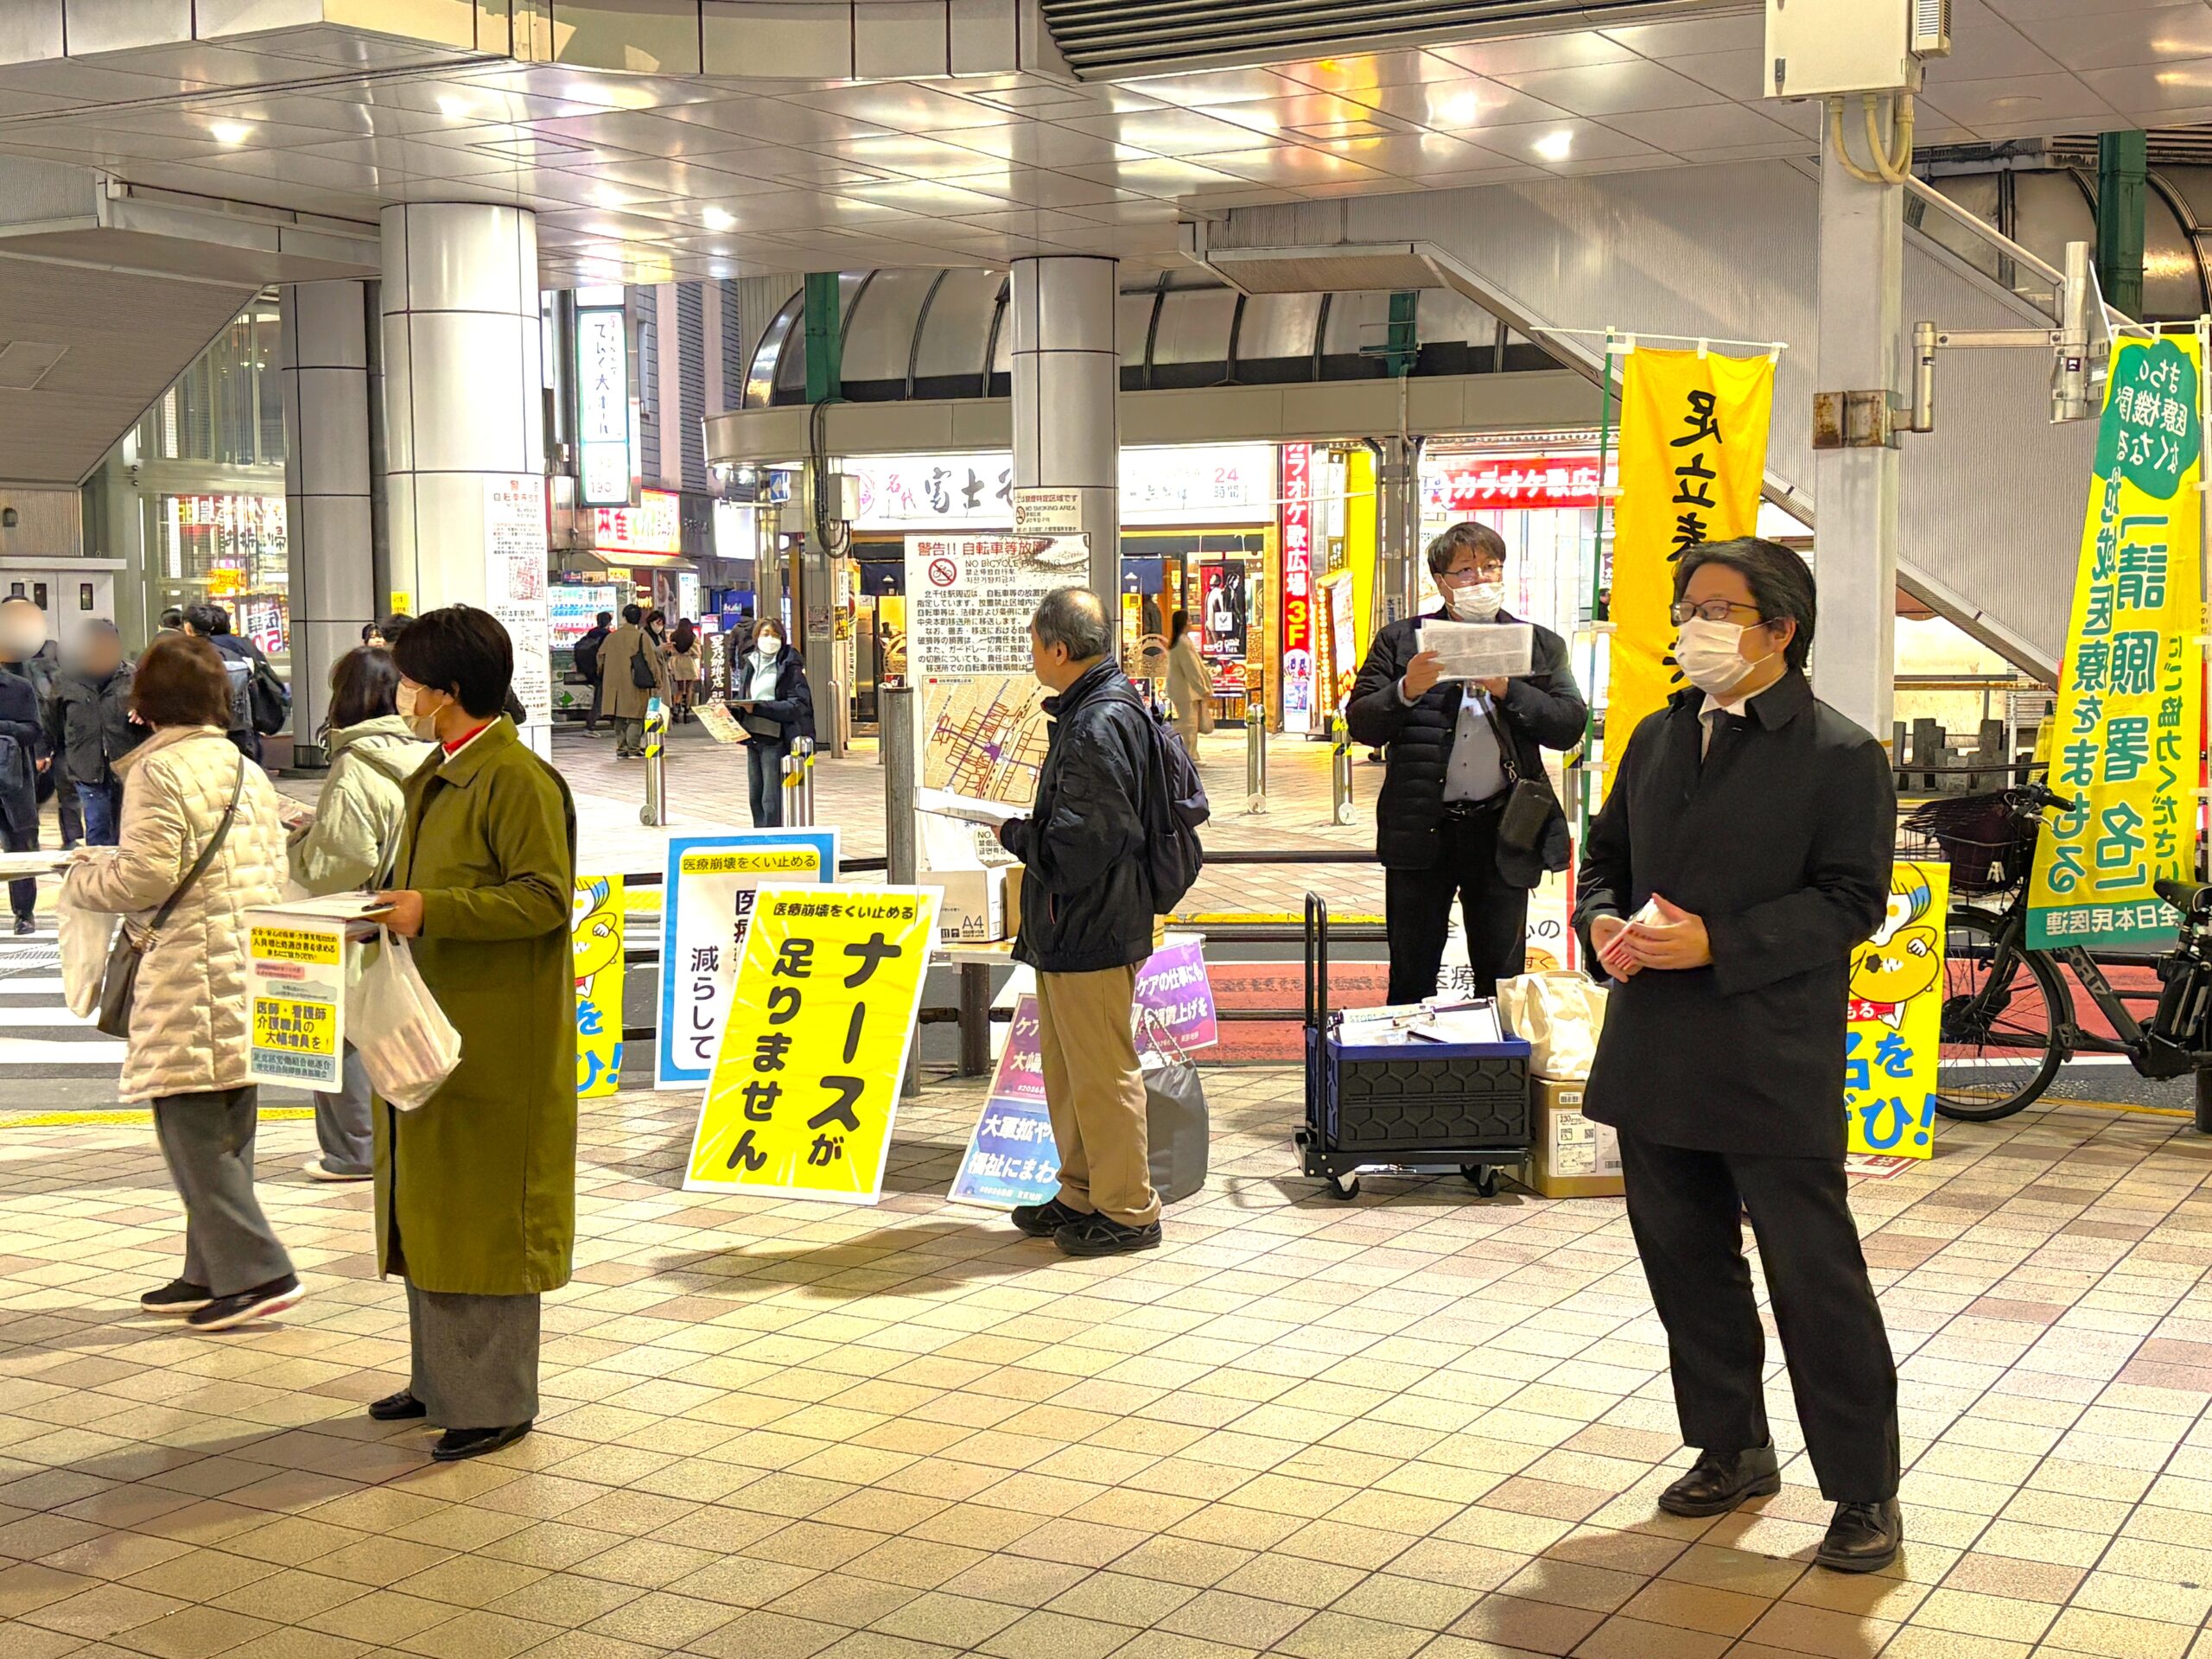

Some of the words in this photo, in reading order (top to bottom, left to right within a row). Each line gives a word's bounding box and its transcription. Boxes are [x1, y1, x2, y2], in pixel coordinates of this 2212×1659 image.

[1214, 467, 1239, 483] 24
[1453, 467, 1618, 499] カラオケ歌広
[1287, 601, 1307, 646] 3F
[683, 855, 817, 871] 医療崩壊をくい止める
[772, 902, 914, 920] 医療崩壊をくい止める
[962, 915, 985, 930] A4
[1136, 961, 1205, 997] ケアの仕事にも
[690, 945, 720, 1059] 減らして
[726, 938, 815, 1172] 足りません
[806, 932, 902, 1166] ナースが
